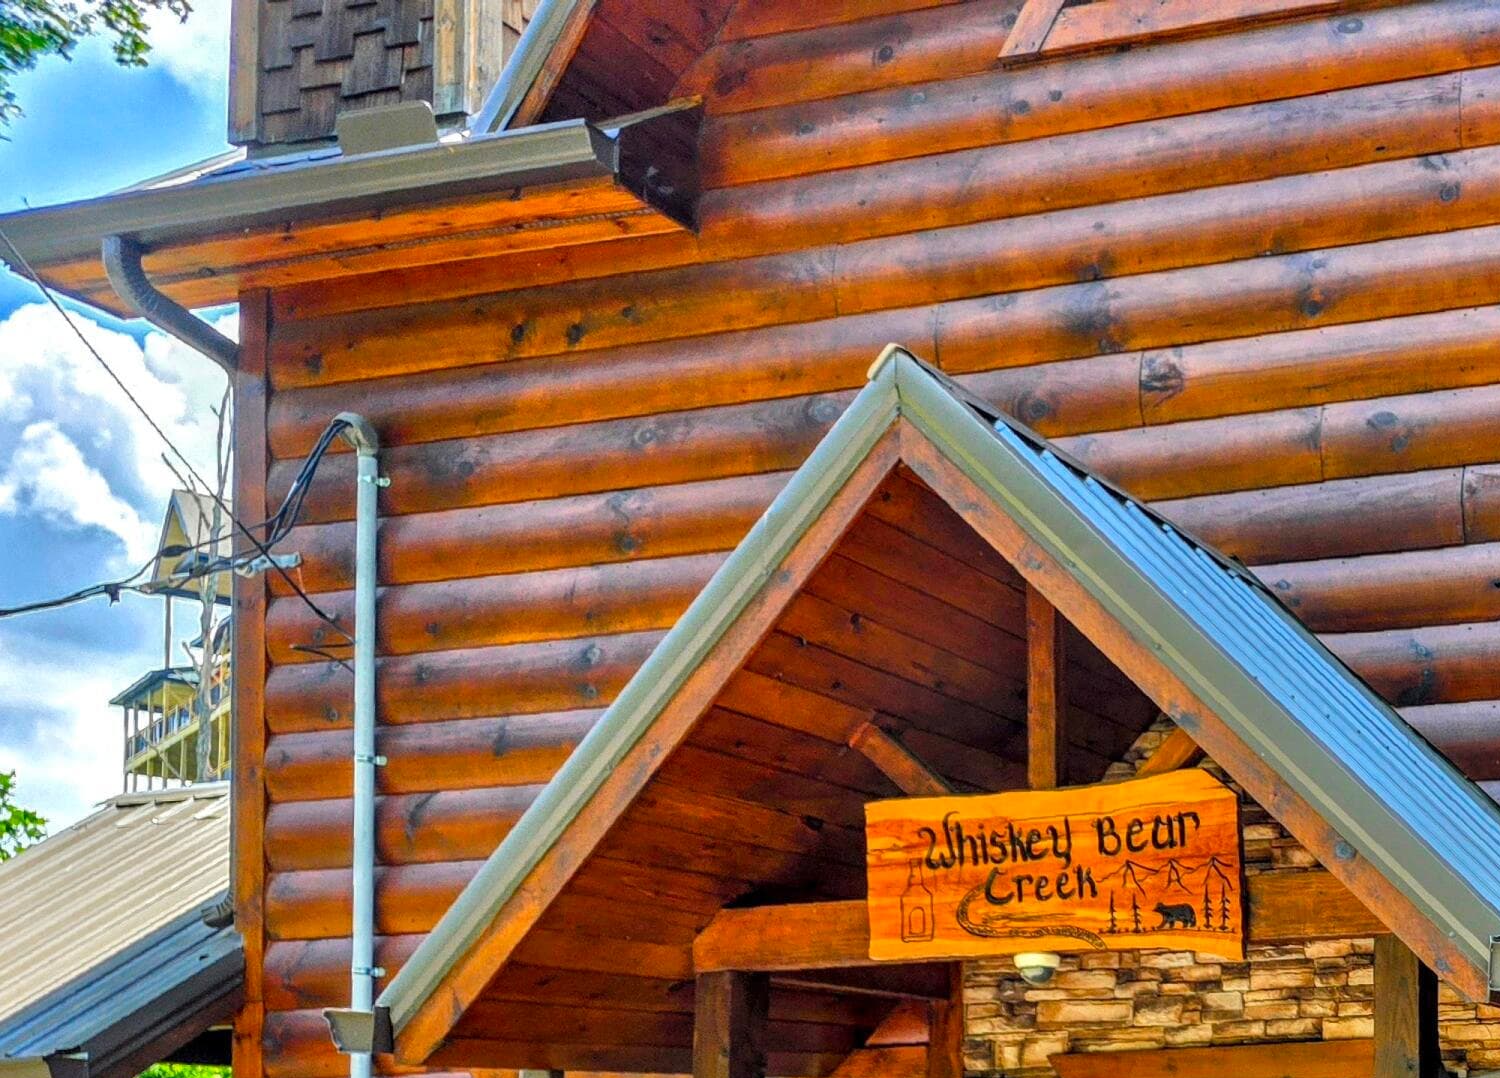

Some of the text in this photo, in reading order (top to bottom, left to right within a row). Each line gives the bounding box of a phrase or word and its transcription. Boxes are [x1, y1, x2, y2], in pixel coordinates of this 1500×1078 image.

[919, 811, 1200, 869] Whiskey Bear
[984, 864, 1098, 905] Creek
